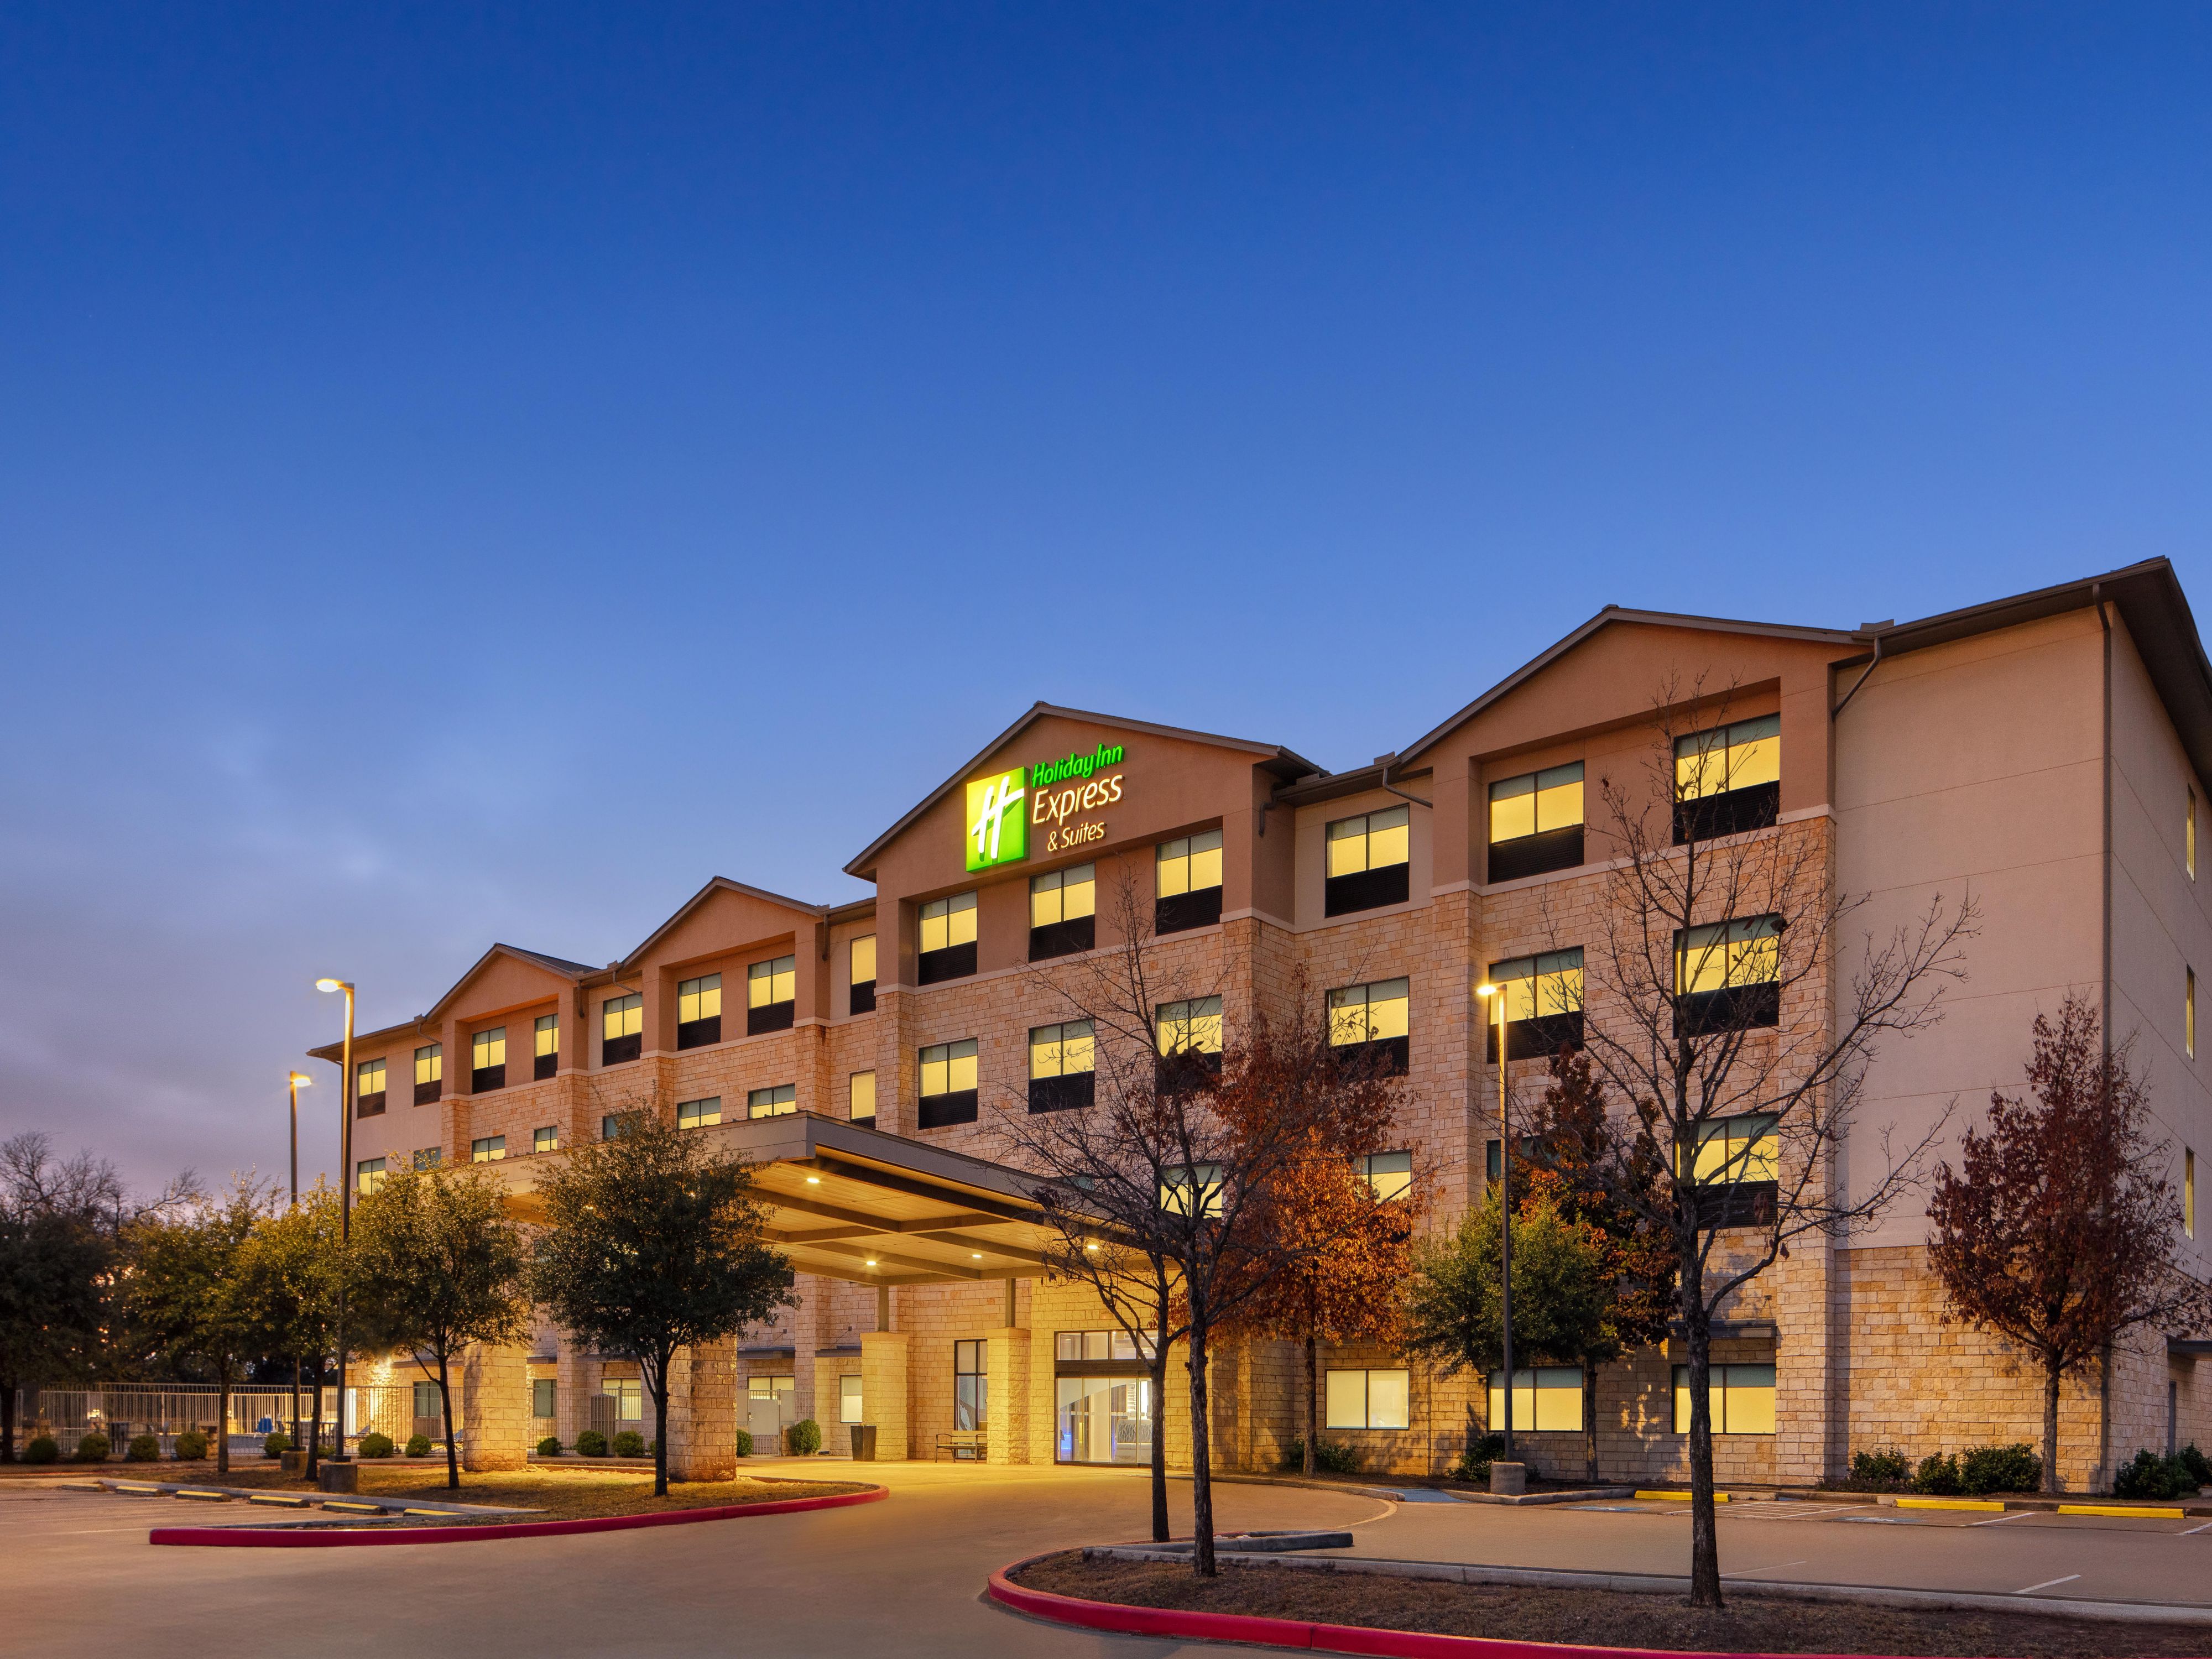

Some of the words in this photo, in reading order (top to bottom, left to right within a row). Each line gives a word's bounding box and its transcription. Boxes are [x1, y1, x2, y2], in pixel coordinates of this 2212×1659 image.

[1032, 753, 1095, 787] Holiday
[1096, 743, 1123, 769] Inn
[1032, 775, 1123, 826] Express
[1047, 831, 1057, 852] &
[1061, 822, 1104, 848] Suites
